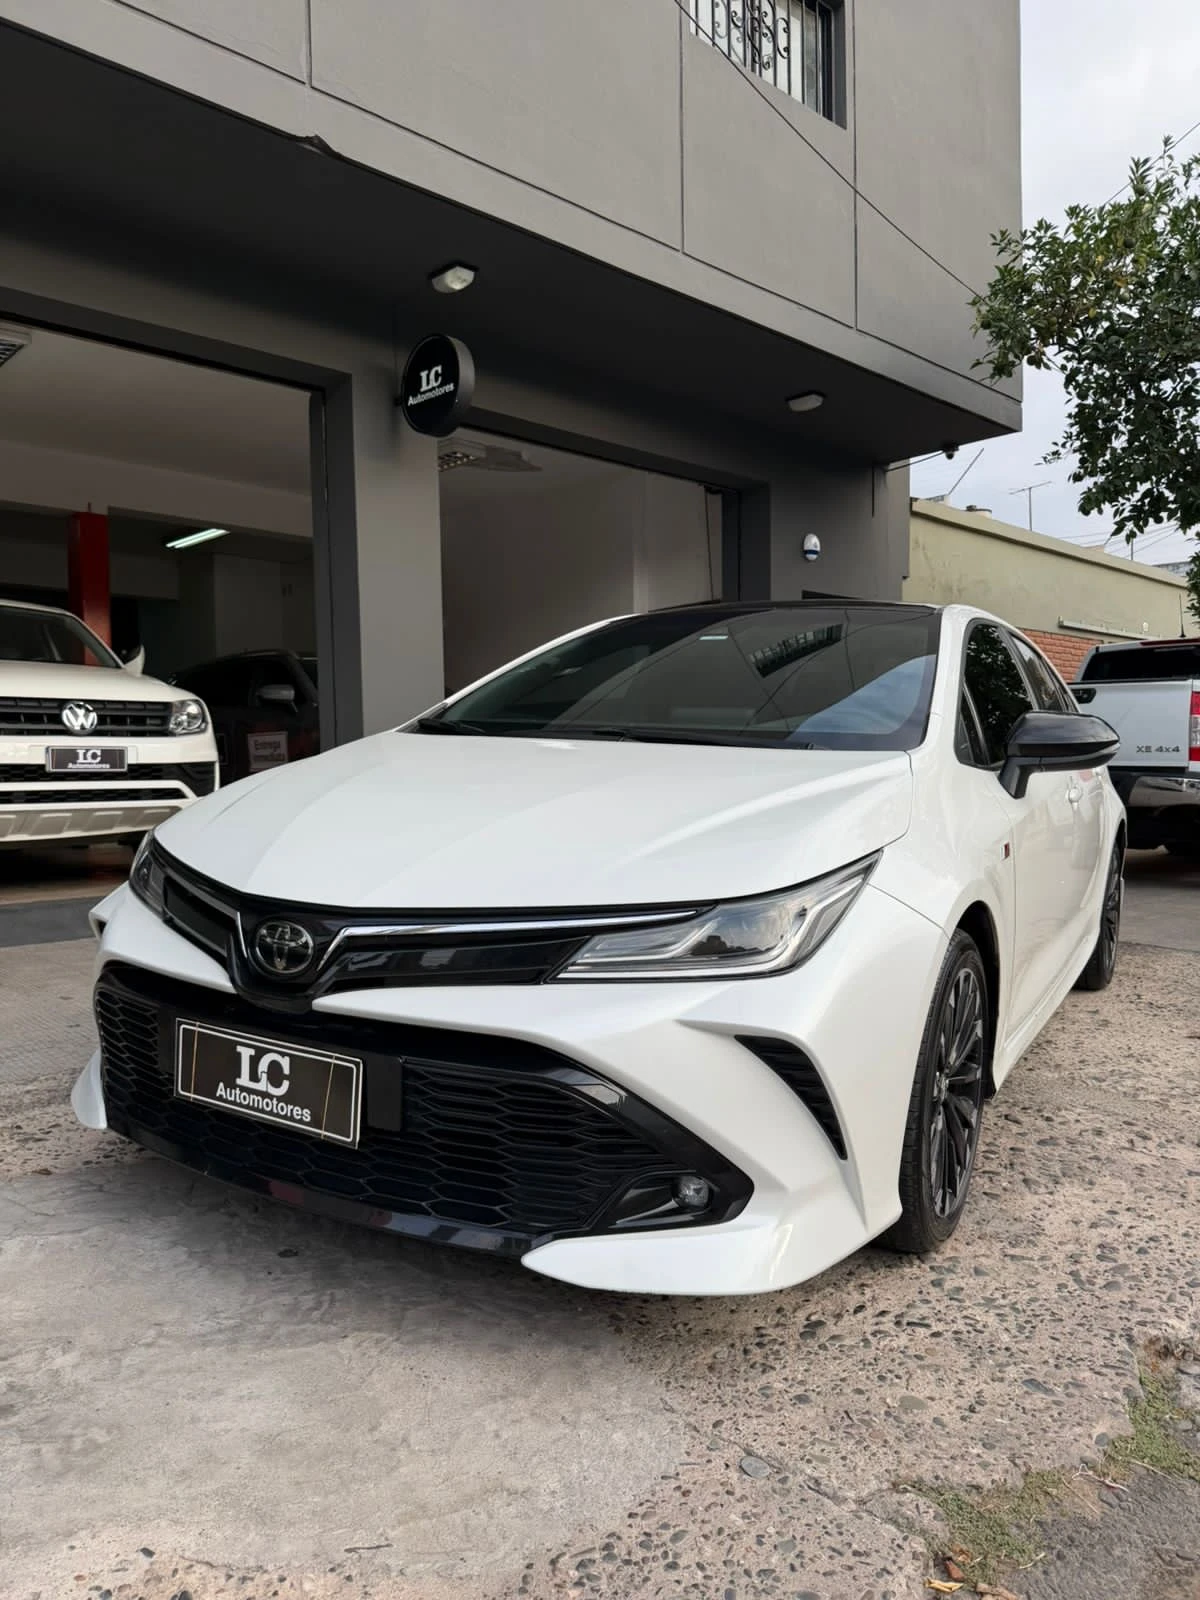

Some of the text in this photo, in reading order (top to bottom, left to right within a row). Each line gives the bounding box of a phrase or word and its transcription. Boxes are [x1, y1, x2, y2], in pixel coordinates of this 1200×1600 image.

[420, 365, 443, 392] LC
[408, 383, 455, 406] Automotores
[76, 749, 102, 764] LC
[1136, 745, 1180, 753] XE 4x4
[236, 1045, 290, 1096] LC
[216, 1082, 311, 1122] Automotores
